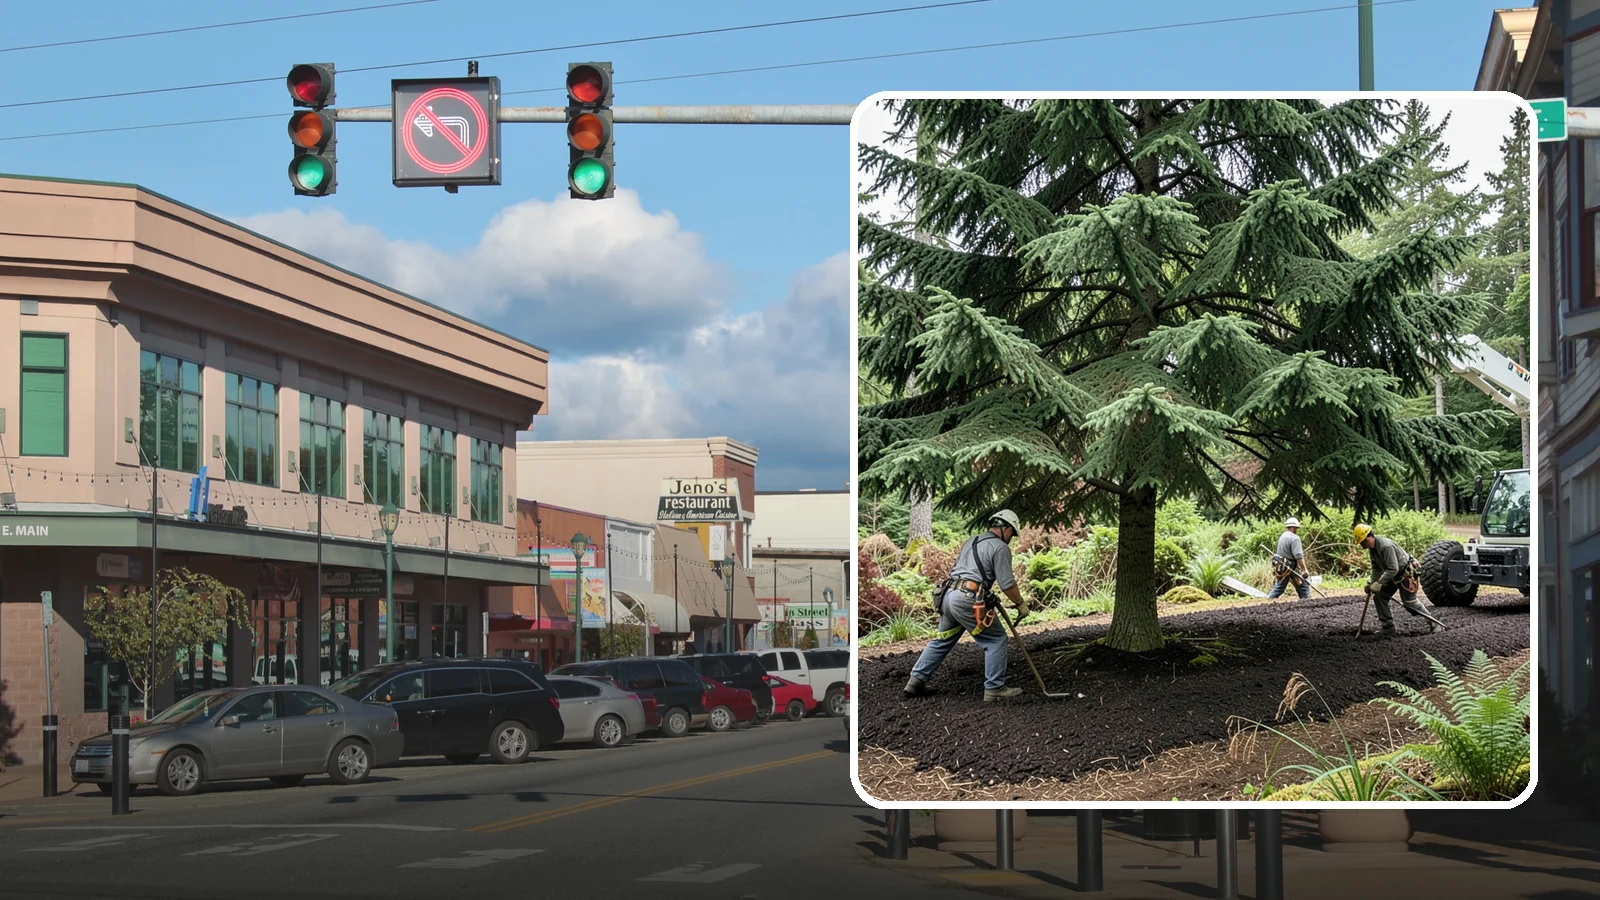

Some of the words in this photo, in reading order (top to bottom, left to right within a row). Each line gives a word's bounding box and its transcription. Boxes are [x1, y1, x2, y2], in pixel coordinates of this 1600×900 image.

[669, 480, 727, 495] Jeno's
[665, 497, 731, 509] restaurant
[658, 510, 681, 519] Italian
[686, 510, 714, 519] American
[714, 510, 737, 519] Cuisine
[2, 525, 13, 536] E.
[15, 525, 49, 536] MAIN
[798, 608, 828, 616] Street
